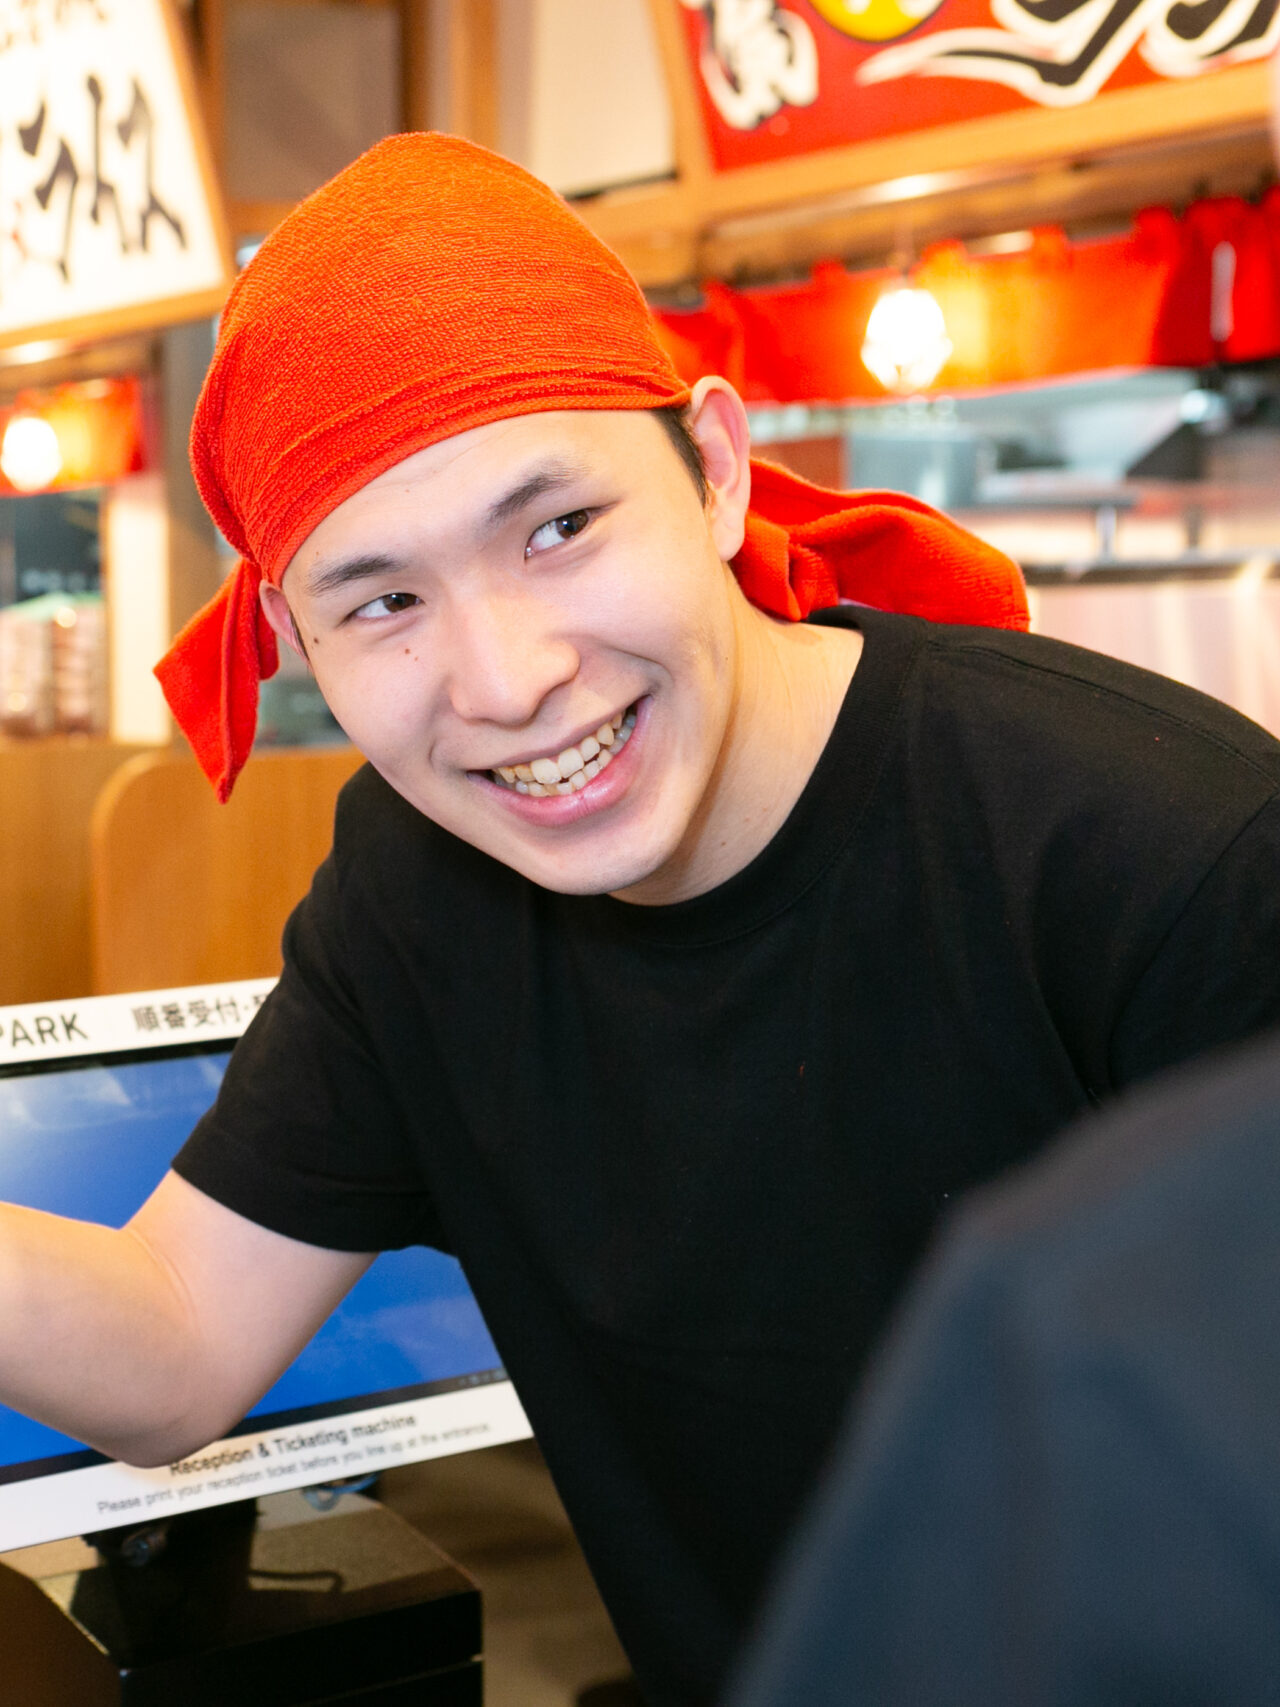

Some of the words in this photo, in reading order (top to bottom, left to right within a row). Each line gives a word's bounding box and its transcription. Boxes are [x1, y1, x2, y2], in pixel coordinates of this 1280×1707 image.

[170, 1447, 254, 1476] Reception
[258, 1442, 271, 1458] &
[275, 1428, 349, 1453] Ticketing
[352, 1413, 417, 1438] machine
[97, 1496, 142, 1513] Please
[146, 1488, 173, 1506] print
[176, 1481, 203, 1499] your
[206, 1470, 261, 1492] reception
[266, 1461, 298, 1478] ticket
[301, 1453, 339, 1471] before
[342, 1449, 364, 1465] you
